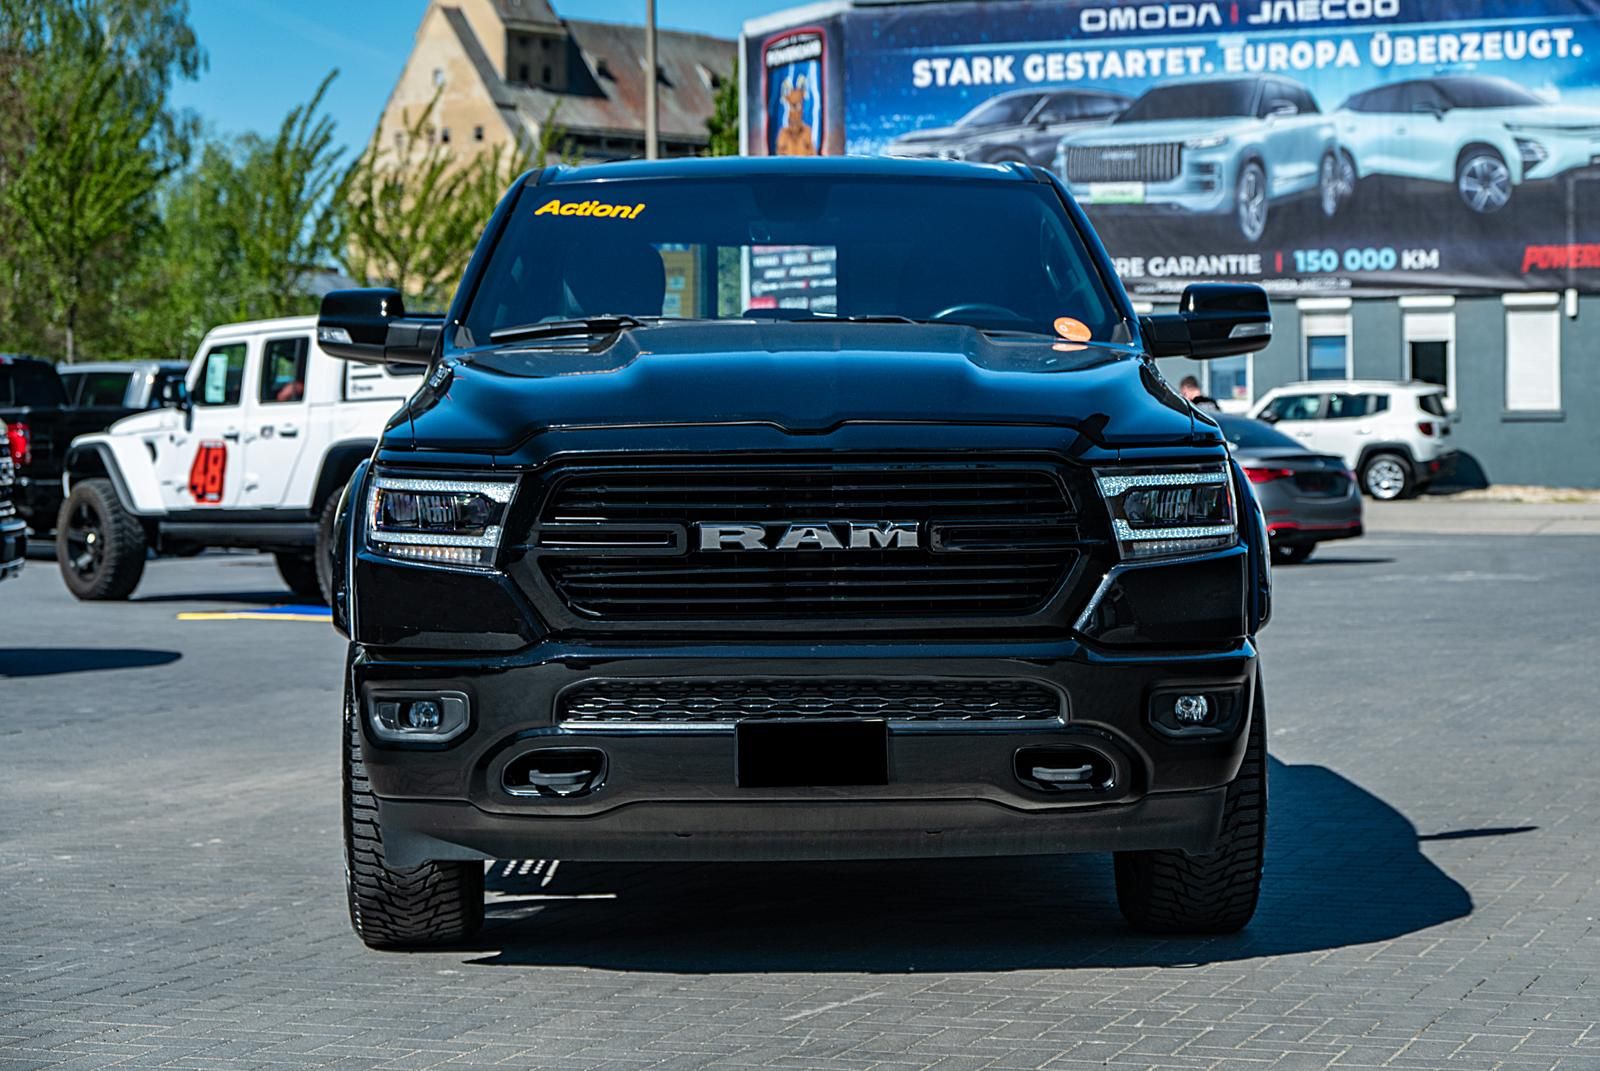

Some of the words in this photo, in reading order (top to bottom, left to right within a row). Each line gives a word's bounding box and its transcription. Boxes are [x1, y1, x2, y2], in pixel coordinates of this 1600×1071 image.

[1079, 5, 1222, 32] OMODA
[1247, 0, 1400, 24] JAECOO
[911, 54, 1015, 88] STARK
[1023, 46, 1214, 82] GESTARTET.
[1223, 40, 1361, 73] EUROPA
[1370, 28, 1583, 67] ÜBERZEUGT.
[534, 199, 646, 219] Action!
[1111, 257, 1145, 277] RE
[1147, 254, 1262, 277] GARANTIE
[1294, 249, 1339, 273] 150
[1343, 248, 1397, 271] 000
[1401, 249, 1440, 270] KM
[699, 521, 920, 550] RAM
